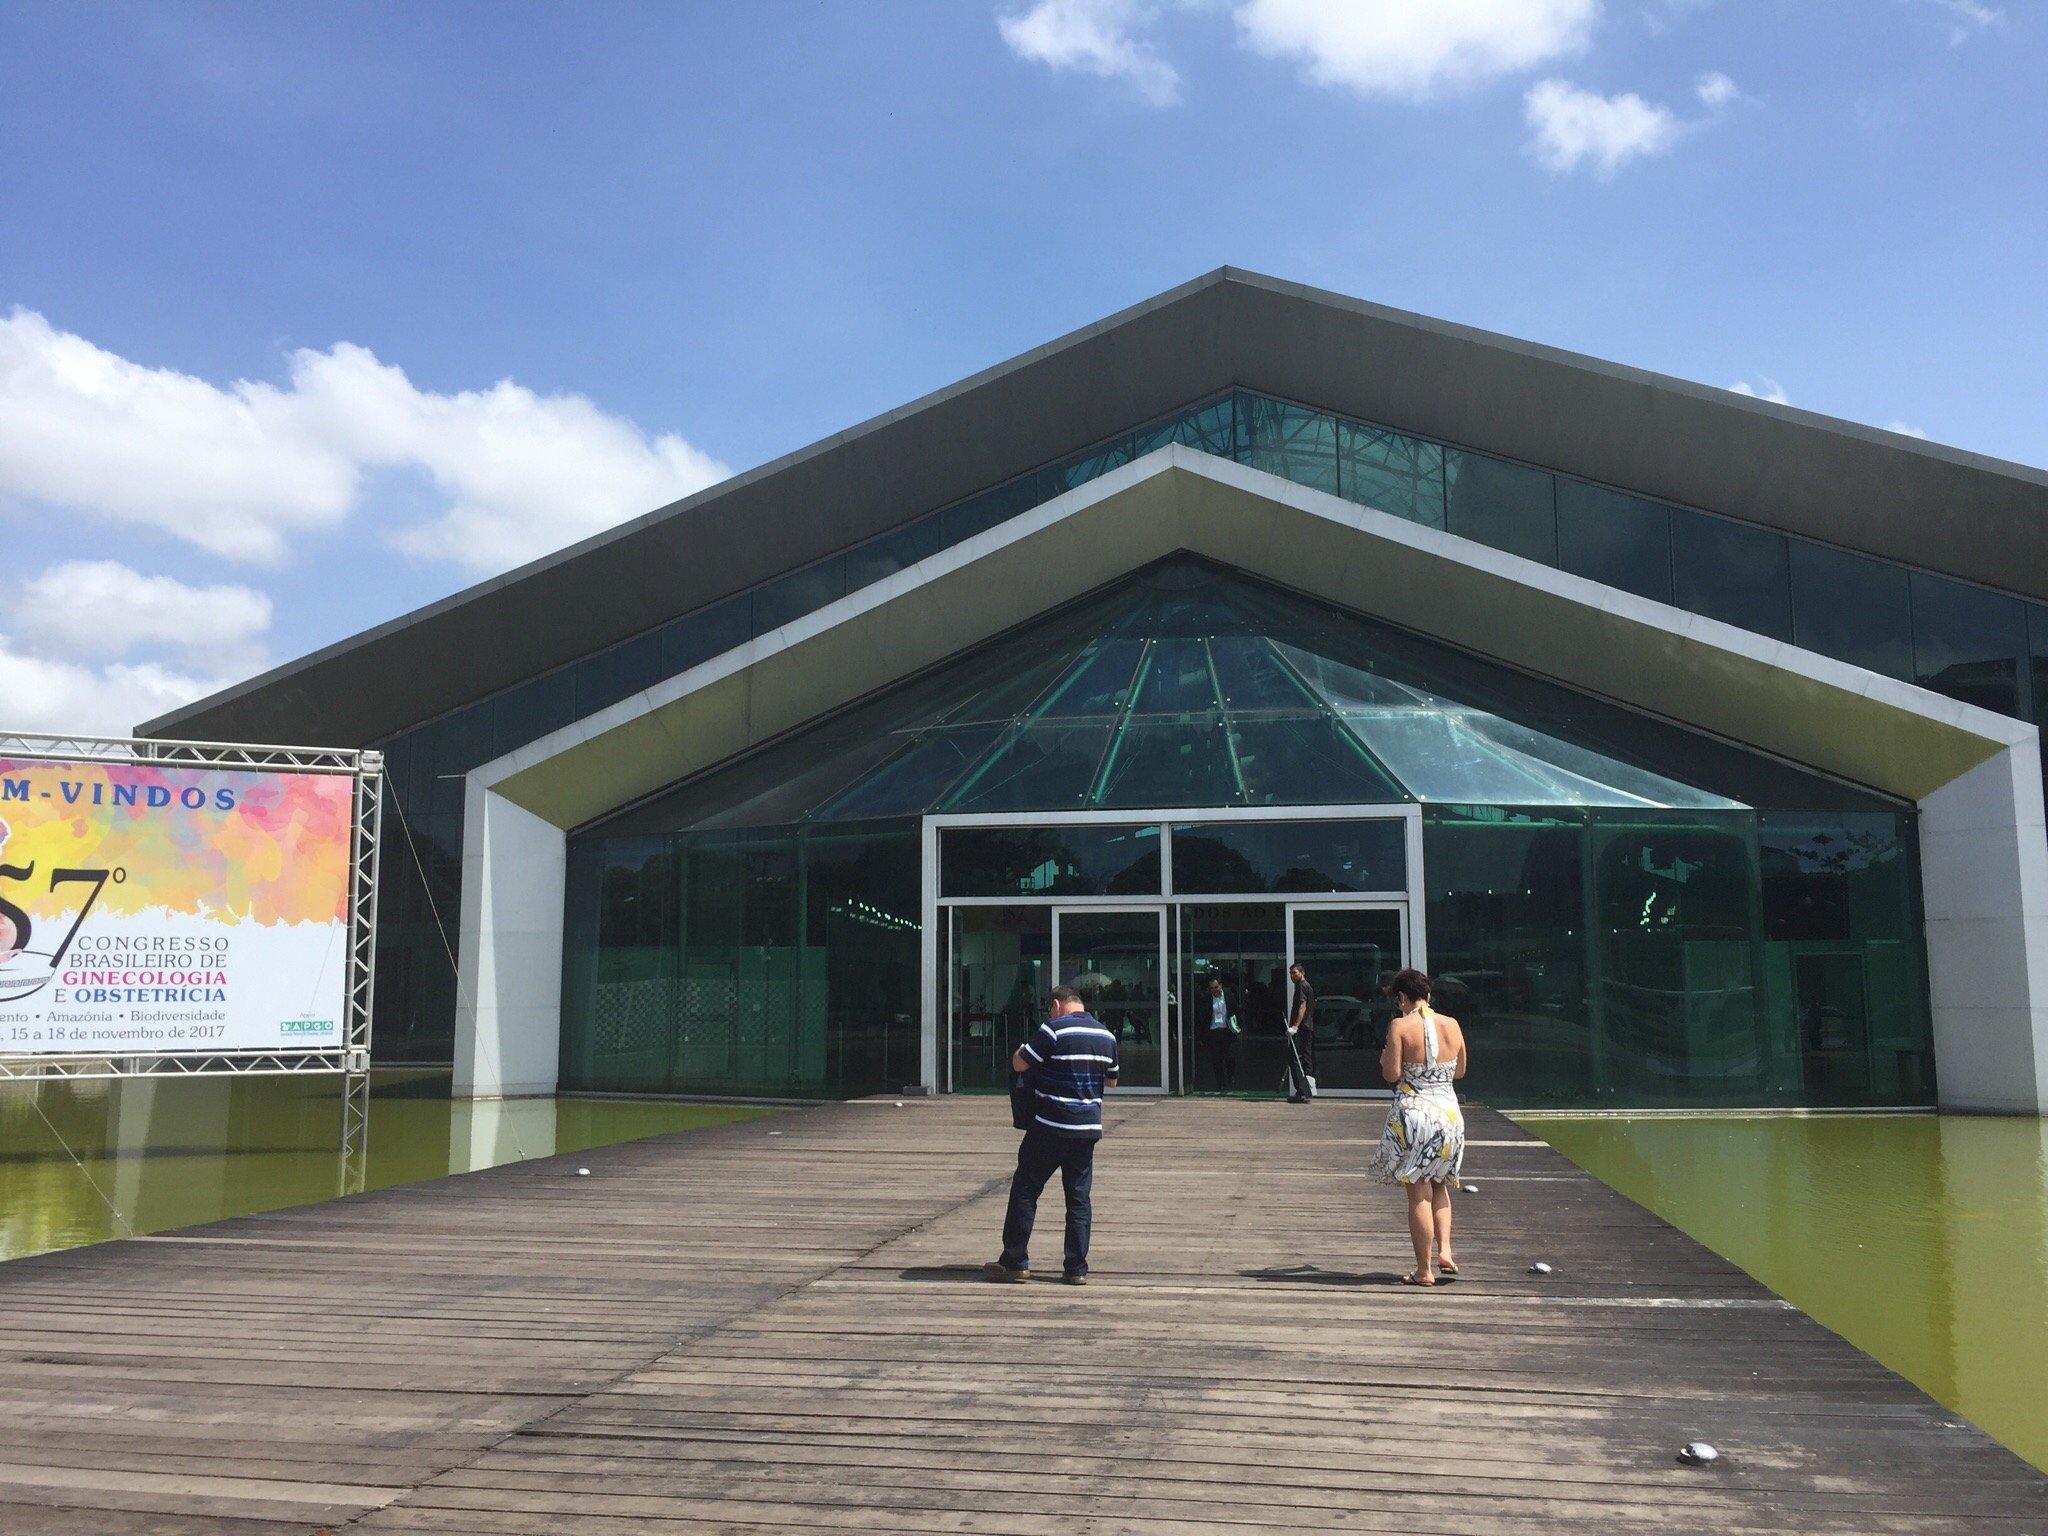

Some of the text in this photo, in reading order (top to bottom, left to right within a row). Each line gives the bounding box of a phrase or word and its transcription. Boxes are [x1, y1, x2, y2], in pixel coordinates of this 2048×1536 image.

[78, 935, 229, 951] CONGRESSO
[70, 953, 227, 968] BRASILEIRO DE
[62, 971, 227, 985] GINECOLOGIA
[54, 985, 226, 1003] E OBSTETRÍCIA
[131, 1010, 226, 1022] Biodiversidade
[12, 1025, 225, 1040] 15 a 18 de novembro de 2017
